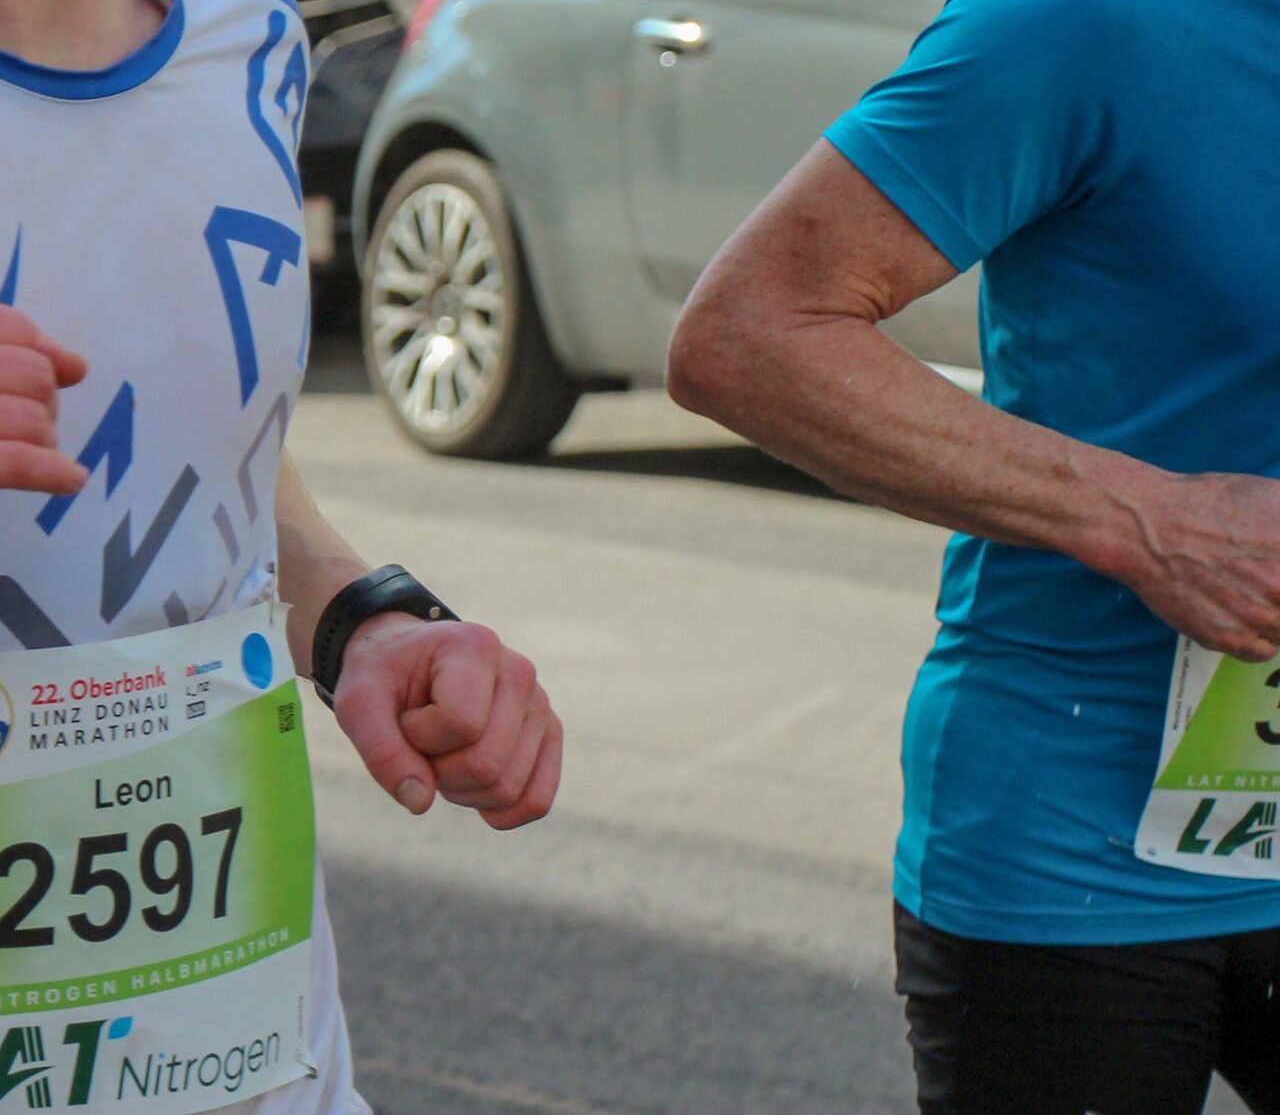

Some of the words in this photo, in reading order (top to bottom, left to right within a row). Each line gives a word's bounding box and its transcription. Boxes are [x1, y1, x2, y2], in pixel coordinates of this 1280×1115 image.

[31, 684, 64, 705] 22.
[71, 665, 167, 701] Oberbank
[30, 707, 81, 727] LINZ
[96, 692, 168, 720] DONAU
[30, 716, 169, 750] MARATHON
[95, 775, 172, 809] Leon
[132, 927, 291, 989] HALBMARATHON
[118, 1032, 281, 1093] Nitrogen
